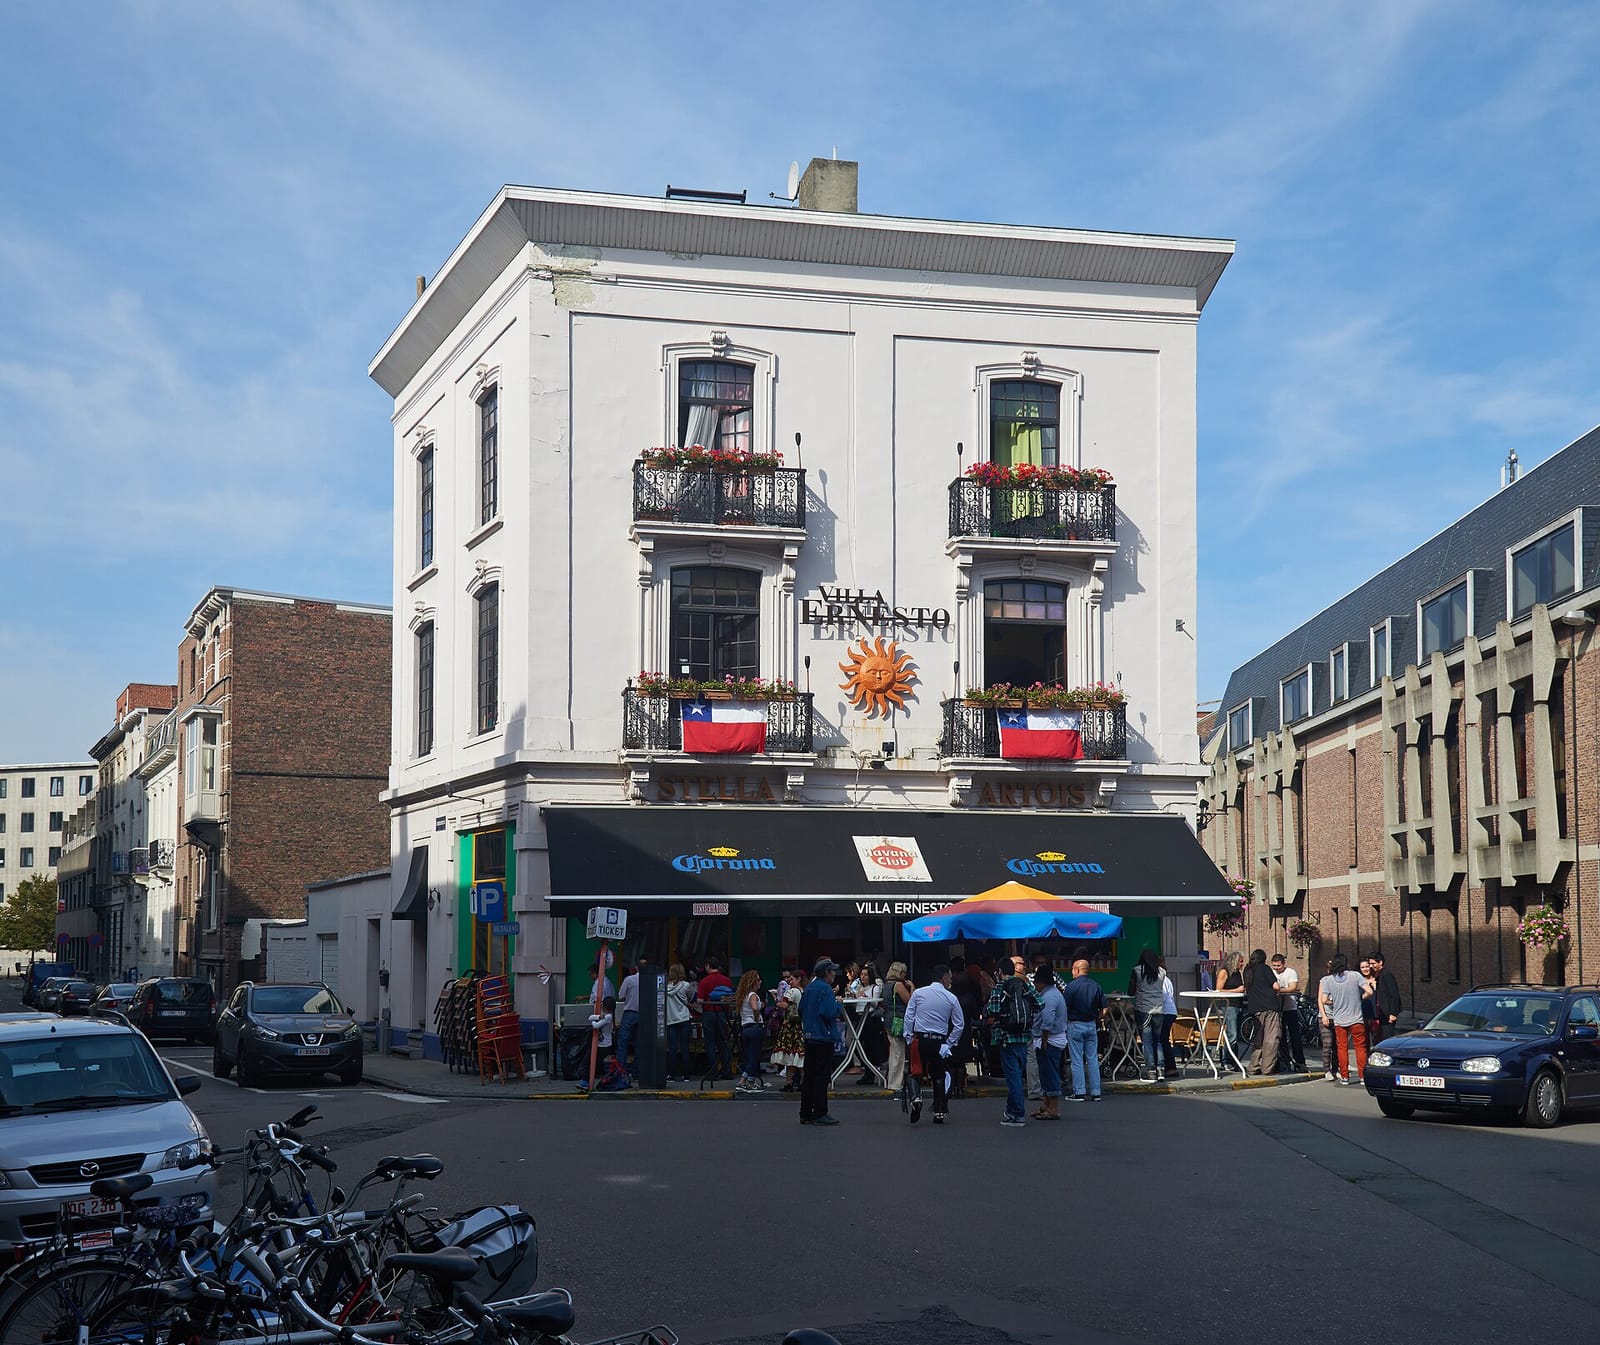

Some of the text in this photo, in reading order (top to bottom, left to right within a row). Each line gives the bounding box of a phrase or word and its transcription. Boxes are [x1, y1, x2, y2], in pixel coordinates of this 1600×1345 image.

[817, 585, 886, 604] VILLA
[799, 598, 950, 631] ERNESTO
[657, 775, 1086, 808] STELLA ARTOIS
[862, 847, 919, 859] Havana
[877, 856, 909, 867] Club
[671, 854, 777, 874] Corona
[1006, 858, 1106, 877] Corona
[481, 888, 500, 916] P
[855, 902, 891, 914] VILLA
[598, 925, 624, 936] TICKET
[1401, 1077, 1442, 1087] 1-EGM-127
